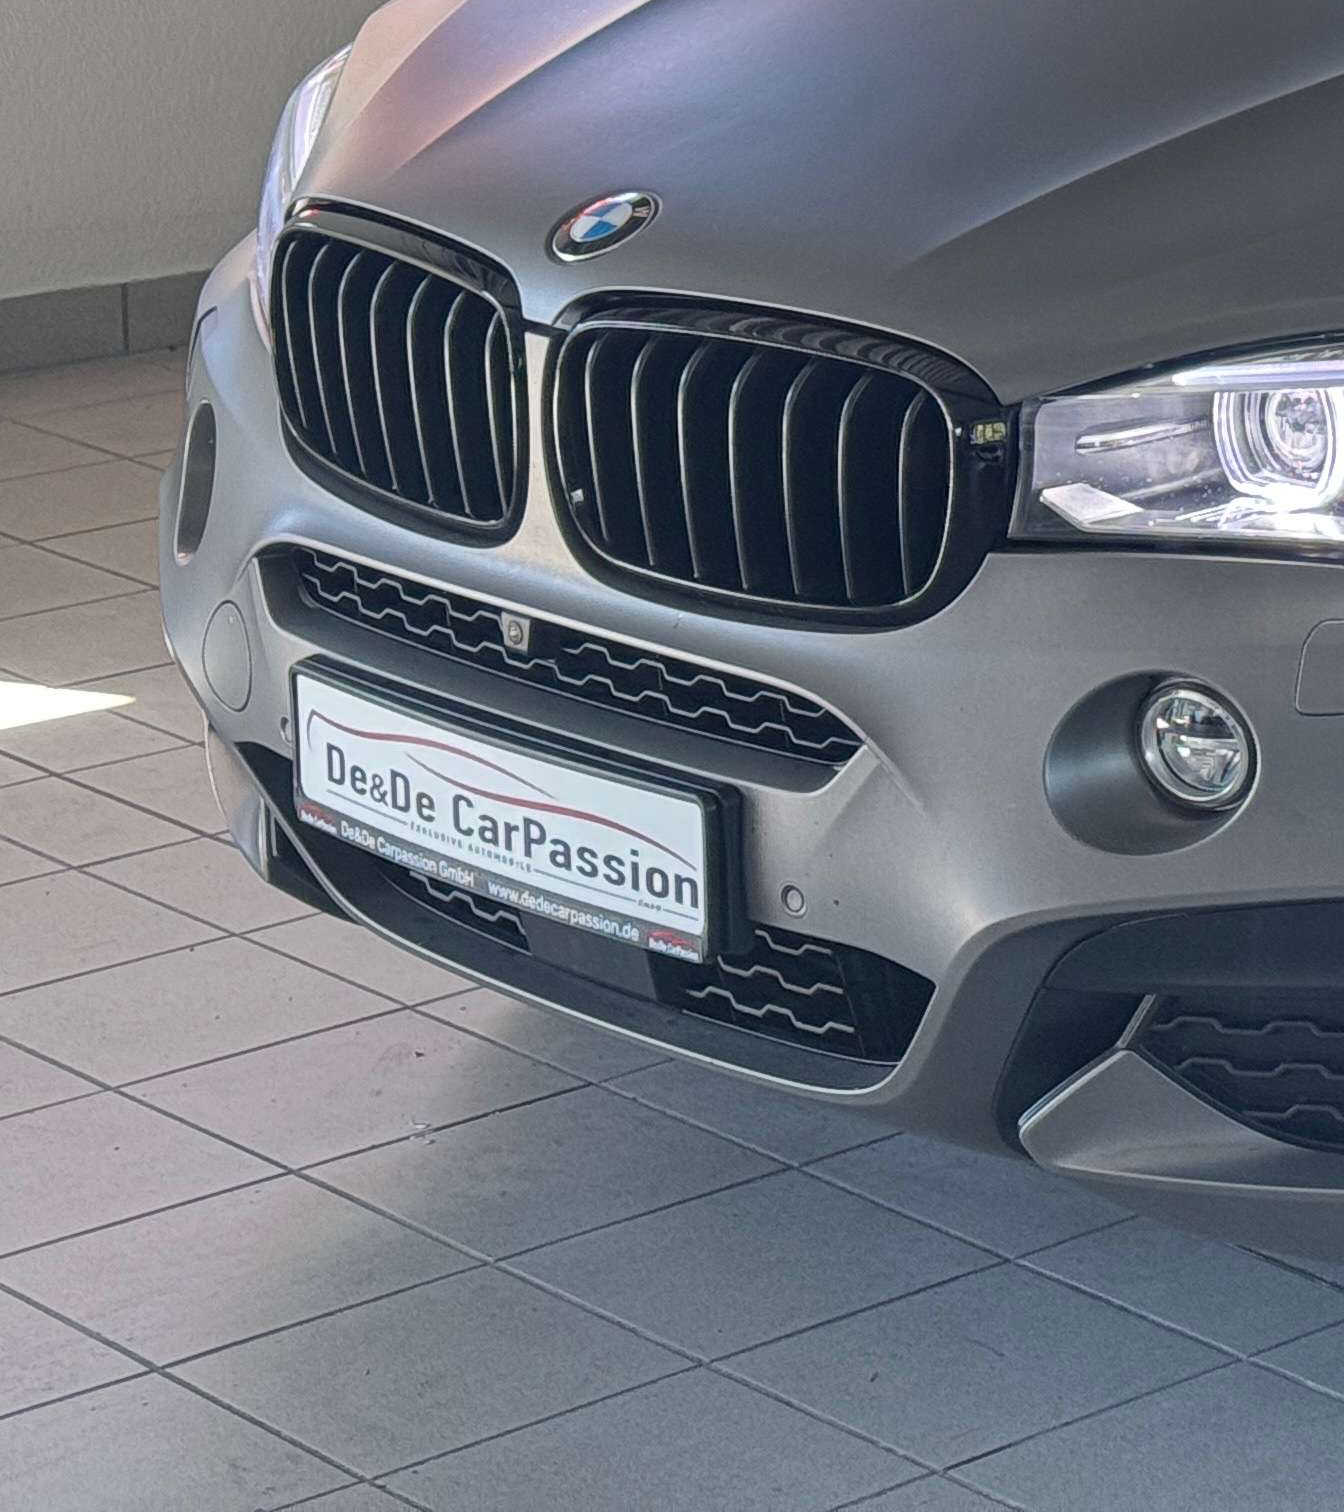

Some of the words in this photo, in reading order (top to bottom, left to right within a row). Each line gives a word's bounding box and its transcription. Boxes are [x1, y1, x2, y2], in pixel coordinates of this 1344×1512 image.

[326, 742, 436, 823] De&De
[452, 794, 699, 909] CarPassion
[340, 820, 376, 850] De&De
[377, 837, 438, 874] Carpassion
[438, 860, 475, 887] GmbH
[487, 881, 640, 942] www.dedecarpassion.de
